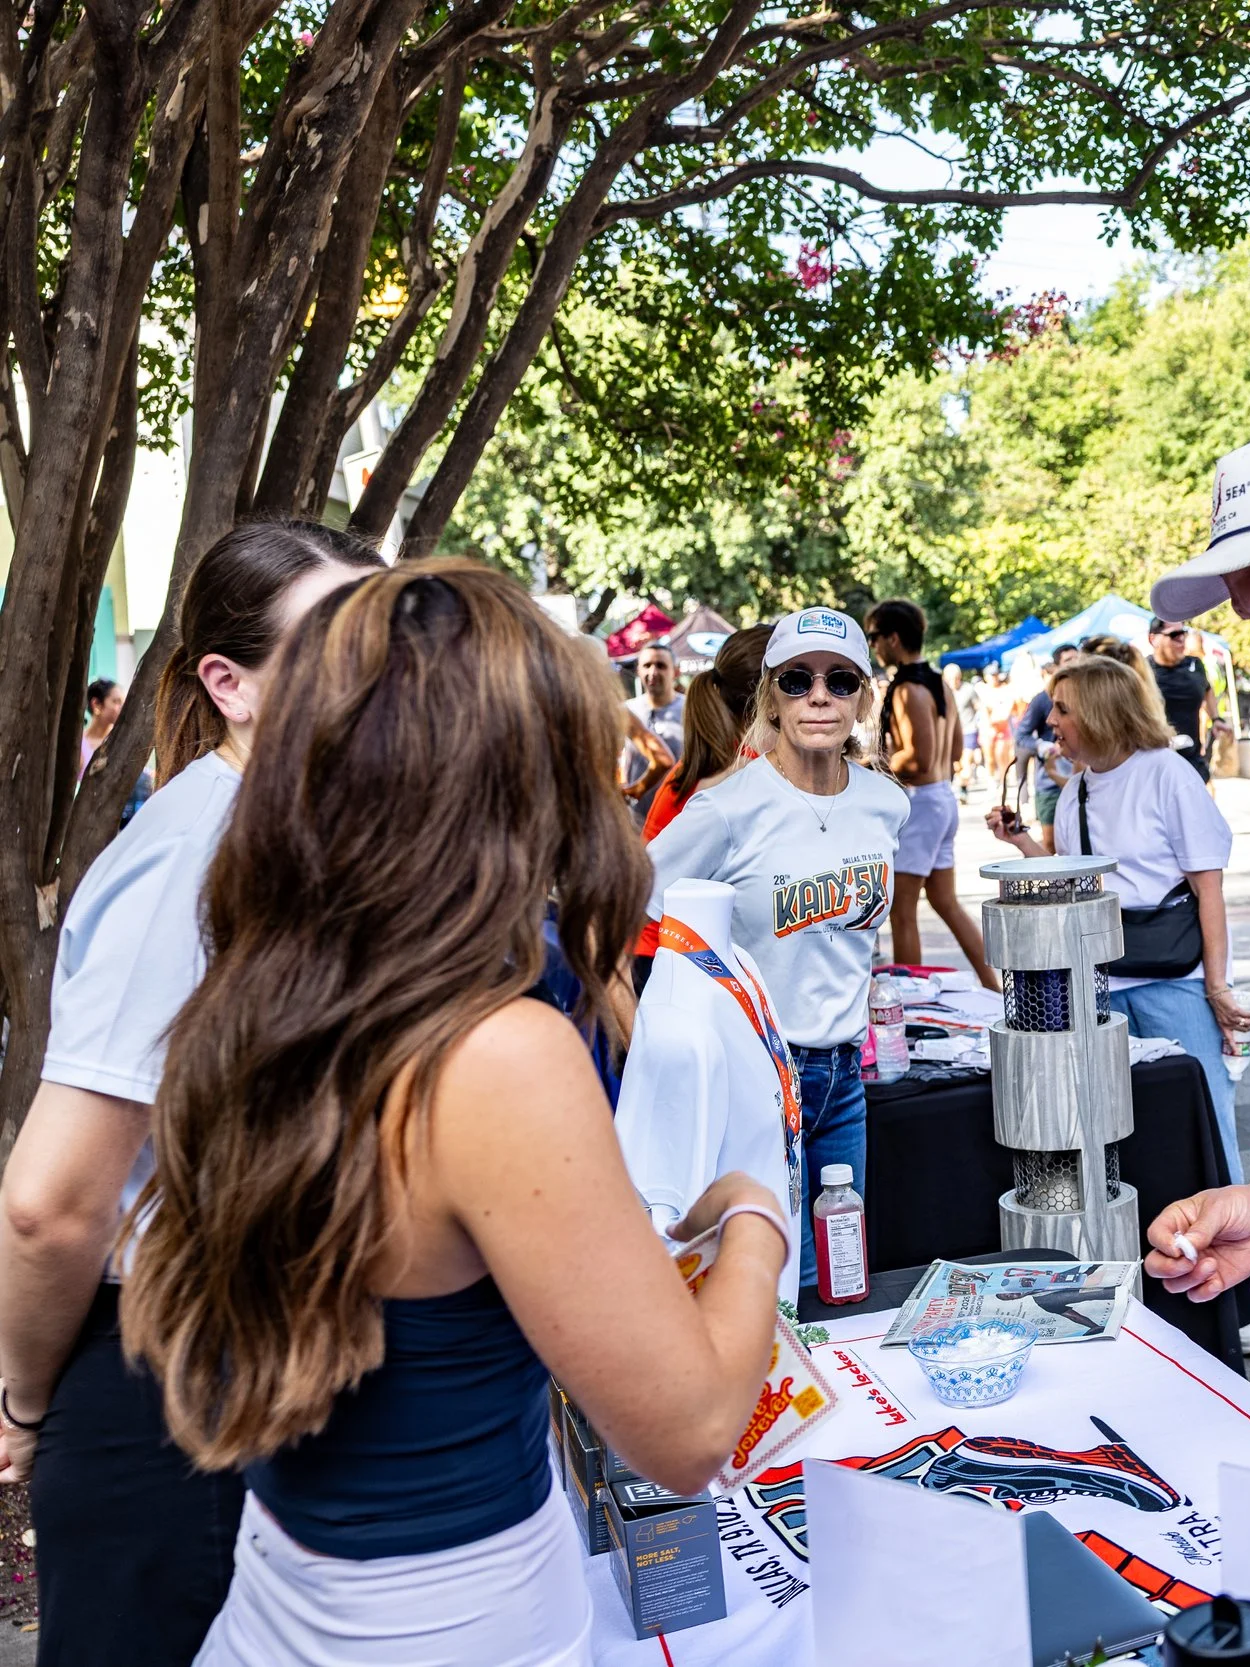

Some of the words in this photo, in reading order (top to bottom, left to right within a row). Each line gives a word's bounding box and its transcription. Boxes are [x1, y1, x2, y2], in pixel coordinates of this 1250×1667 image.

[773, 867, 850, 938] KATY
[850, 861, 888, 908] 5K
[658, 927, 695, 951] ORTRESS
[1177, 1511, 1222, 1561] TRA
[636, 1552, 658, 1562] MORE
[660, 1546, 681, 1556] SALT,
[636, 1560, 652, 1568] NOT
[655, 1554, 676, 1564] LESS.
[727, 1539, 768, 1561] TX
